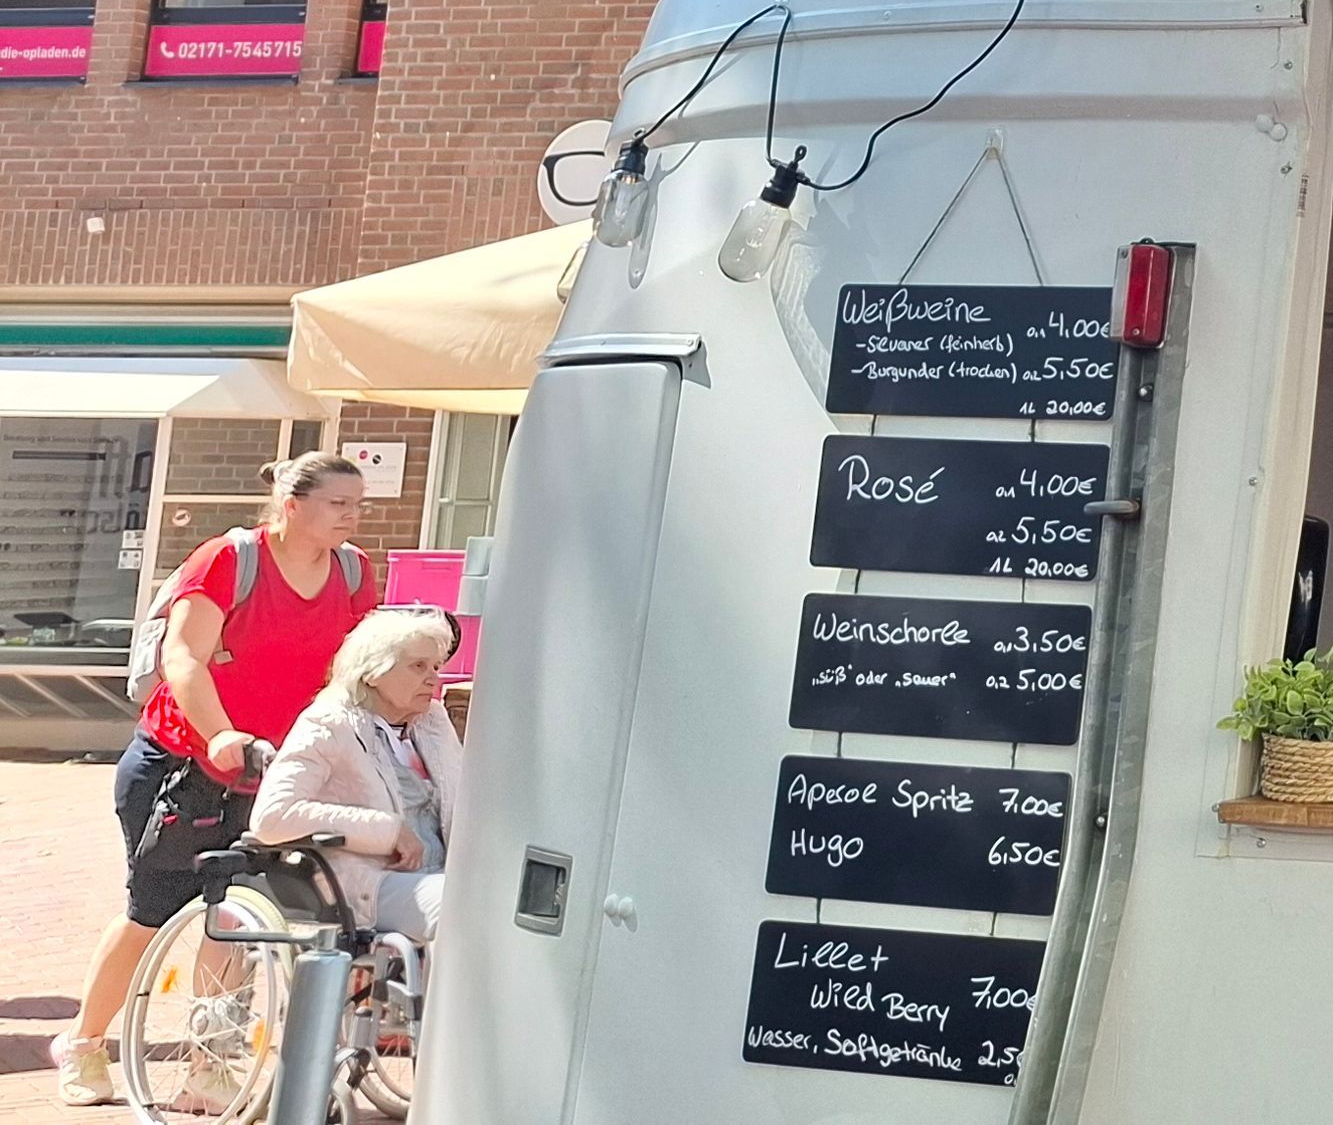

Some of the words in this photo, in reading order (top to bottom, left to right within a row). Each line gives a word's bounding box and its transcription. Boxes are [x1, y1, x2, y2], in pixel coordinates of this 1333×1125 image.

[179, 40, 302, 59] 02171-7545715
[842, 288, 991, 332] Weißweine
[1048, 311, 1111, 339] 4,00€
[940, 333, 1013, 357] (feinherb)
[949, 362, 1018, 384] (trocken)
[1046, 401, 1106, 416] 20,00€
[838, 454, 945, 504] Rosé
[1019, 468, 1097, 499] 4,00€
[1012, 516, 1093, 545] 5,50€
[1024, 557, 1089, 578] 20,00€
[812, 612, 971, 645] Weinschorle
[1014, 626, 1087, 653] 3,50€
[856, 672, 888, 686] oder
[1016, 668, 1083, 692] 5,00€
[787, 773, 877, 810] Aperol
[891, 779, 975, 818] Spritz
[998, 787, 1064, 818] 7,00€
[790, 828, 864, 868] Hugo
[988, 836, 1061, 867] 6,50€
[774, 932, 889, 972] Lillet
[810, 978, 876, 1013] Wild
[881, 992, 950, 1032] Berry
